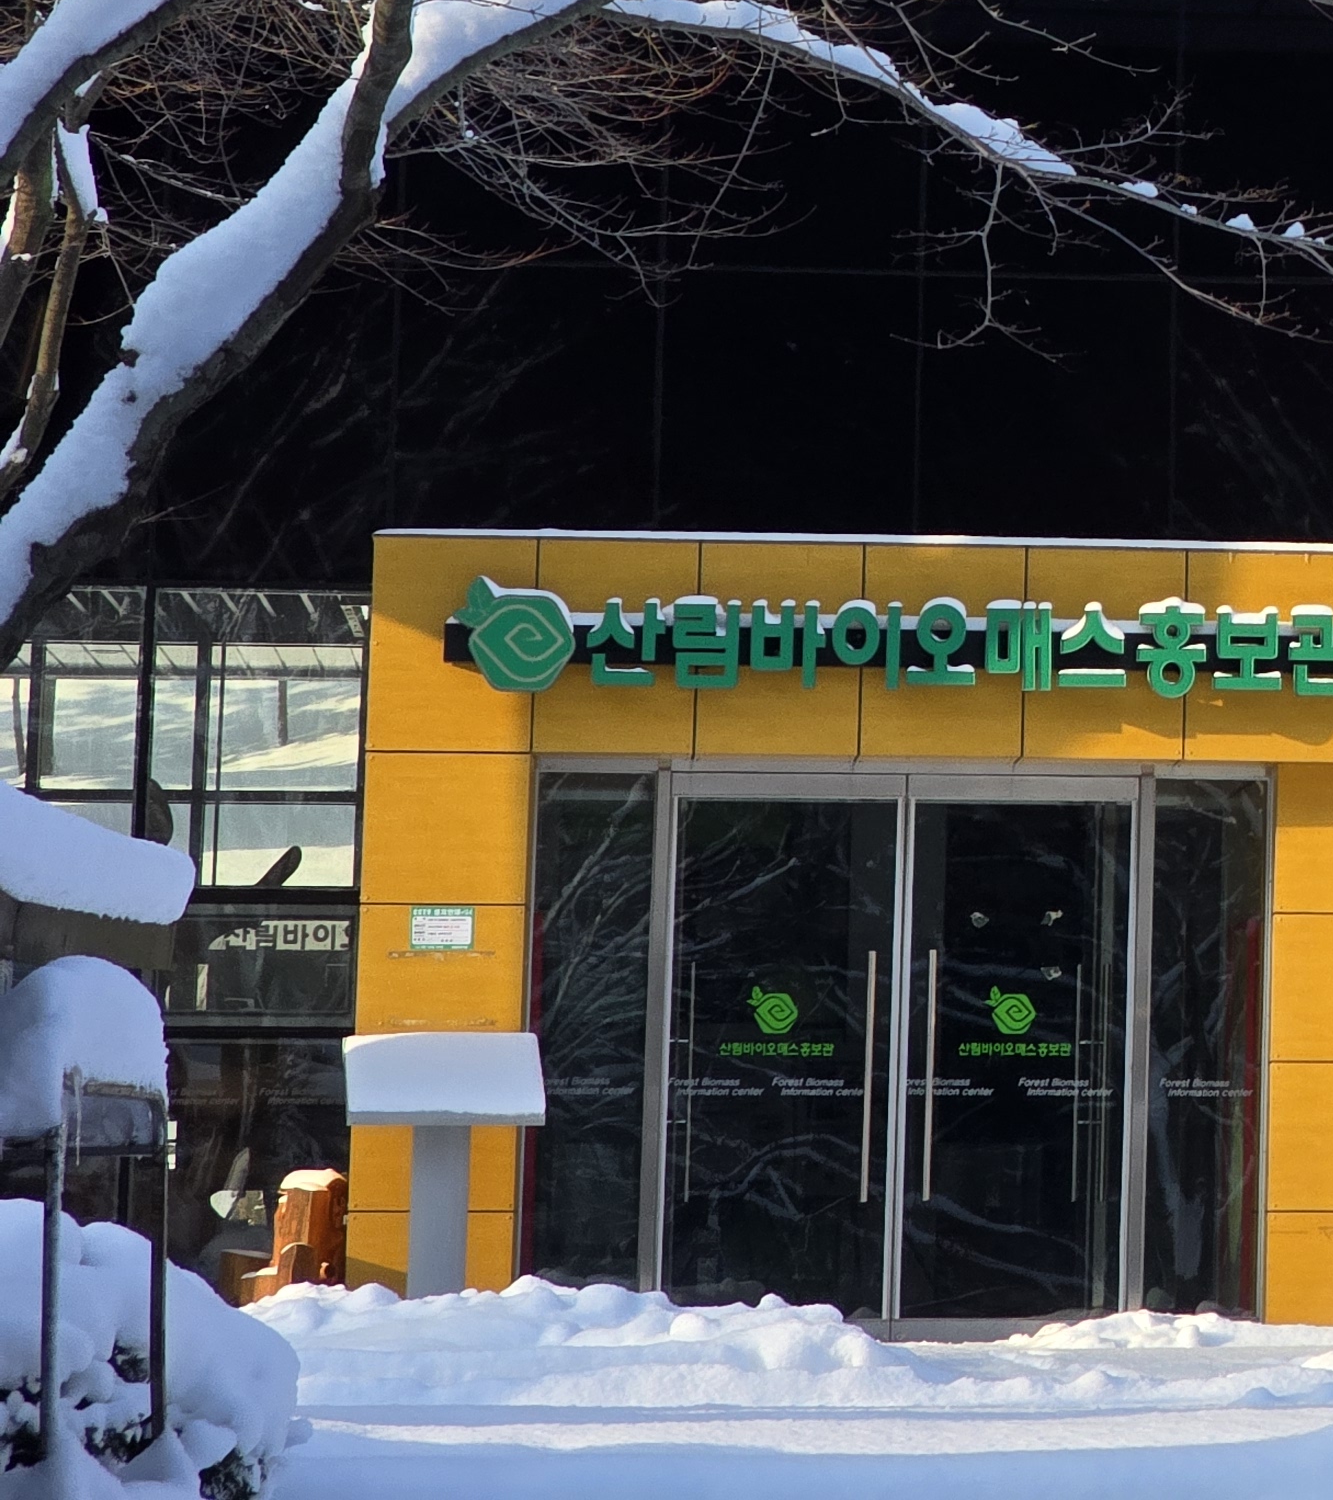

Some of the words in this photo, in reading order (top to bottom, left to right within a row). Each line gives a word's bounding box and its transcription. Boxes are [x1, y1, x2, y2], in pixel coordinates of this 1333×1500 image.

[719, 1042, 835, 1057] 산림바이오매스홍보관
[958, 1041, 1072, 1058] 산림바이오매스홍보관
[545, 1078, 569, 1086] orest
[668, 1077, 700, 1087] Forest
[701, 1077, 741, 1087] Biomass
[772, 1077, 803, 1087] Forest
[805, 1077, 845, 1087] Biomass
[1018, 1077, 1050, 1087] Forest
[1051, 1077, 1089, 1087] Biomass
[1159, 1078, 1190, 1088] Forest
[1192, 1078, 1230, 1088] Biomass
[676, 1087, 730, 1097] Information
[732, 1087, 765, 1097] center
[780, 1087, 833, 1097] Information
[835, 1087, 864, 1097] cente
[962, 1087, 995, 1097] center
[1026, 1087, 1079, 1097] Information
[1081, 1087, 1114, 1097] center
[1167, 1088, 1219, 1098] Information
[1221, 1088, 1254, 1098] center
